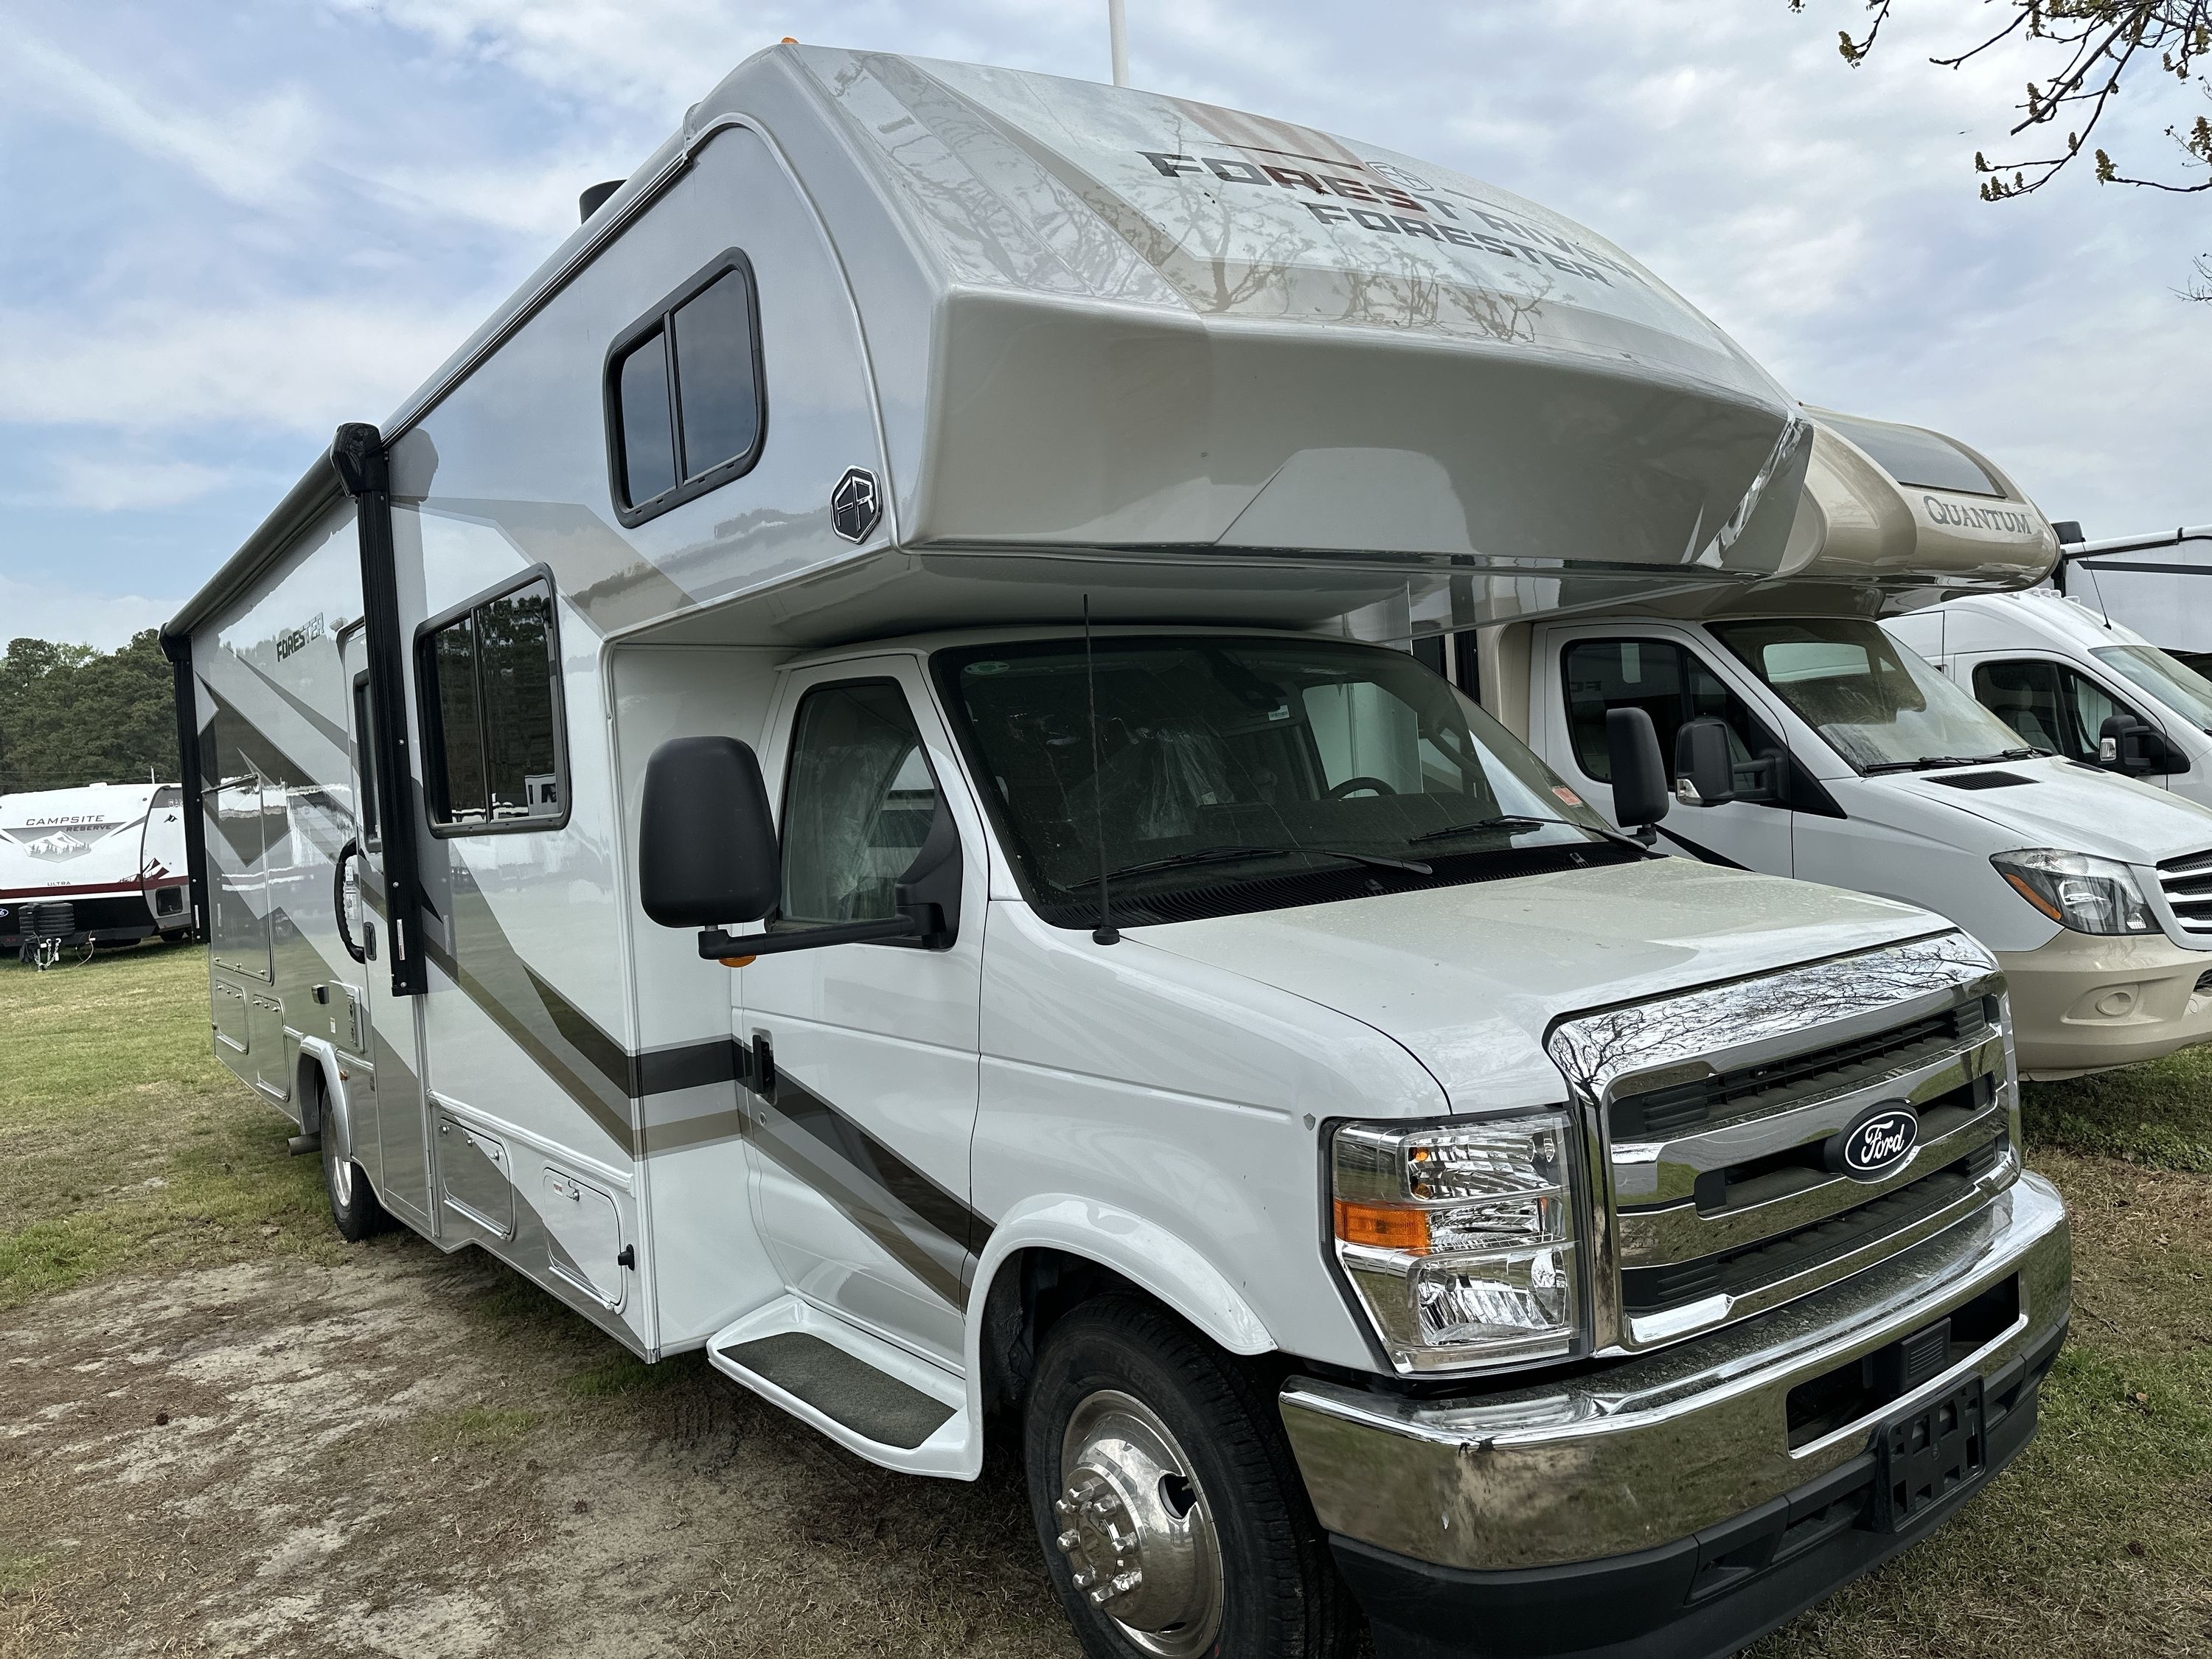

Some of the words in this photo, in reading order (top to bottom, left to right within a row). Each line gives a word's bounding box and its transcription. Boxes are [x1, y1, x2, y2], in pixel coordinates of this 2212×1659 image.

[1136, 150, 1461, 220] FOREST
[1466, 207, 1652, 288] RIVER
[1299, 201, 1616, 289] FORESTER
[1923, 495, 2032, 535] QUANTUM
[276, 612, 324, 662] FORESTER
[26, 815, 105, 826] CAMPSITE
[66, 824, 112, 832] RESERVE
[1861, 1120, 1905, 1164] Ford
